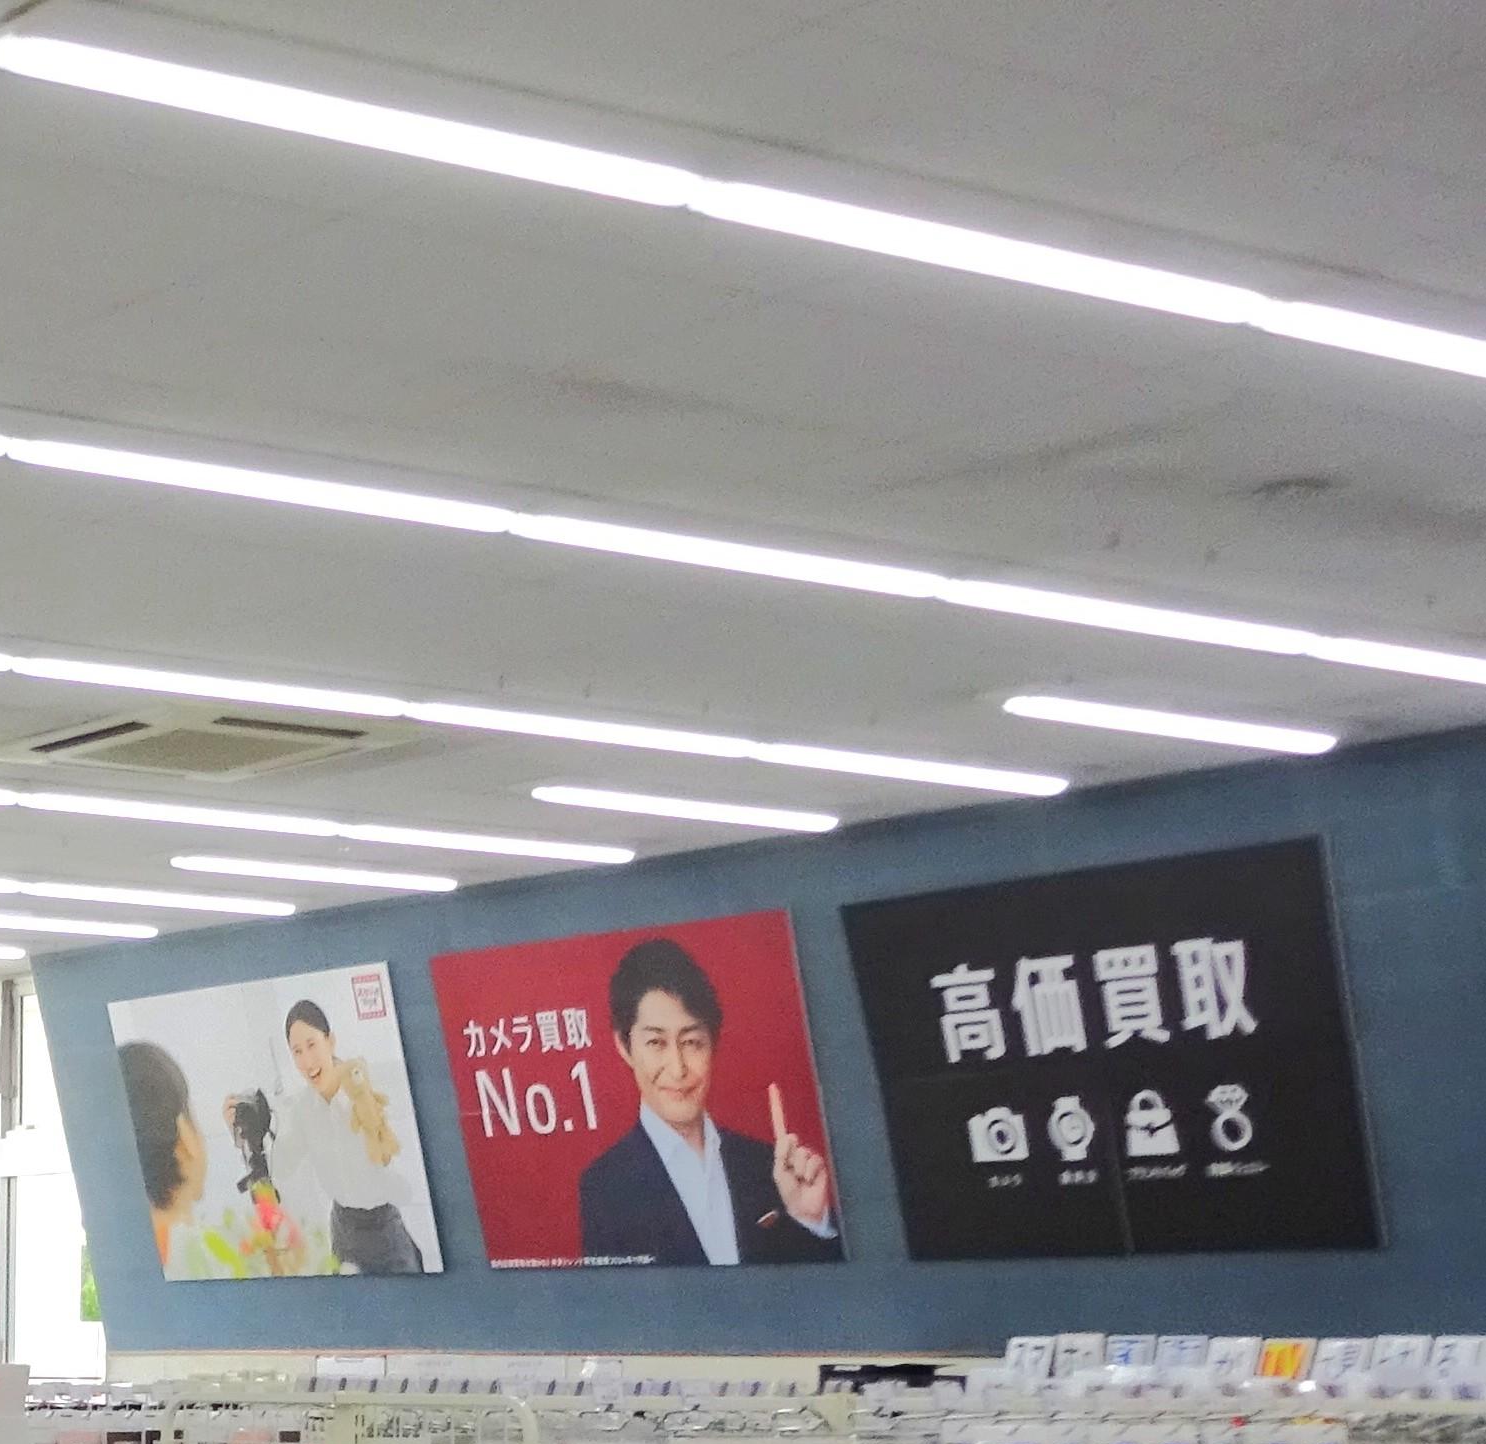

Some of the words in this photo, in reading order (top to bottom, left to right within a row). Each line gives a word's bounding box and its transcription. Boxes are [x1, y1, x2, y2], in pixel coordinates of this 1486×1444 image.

[462, 1006, 593, 1058] カメラ買取
[930, 937, 1259, 1063] 高価買取
[474, 1060, 599, 1138] No.1
